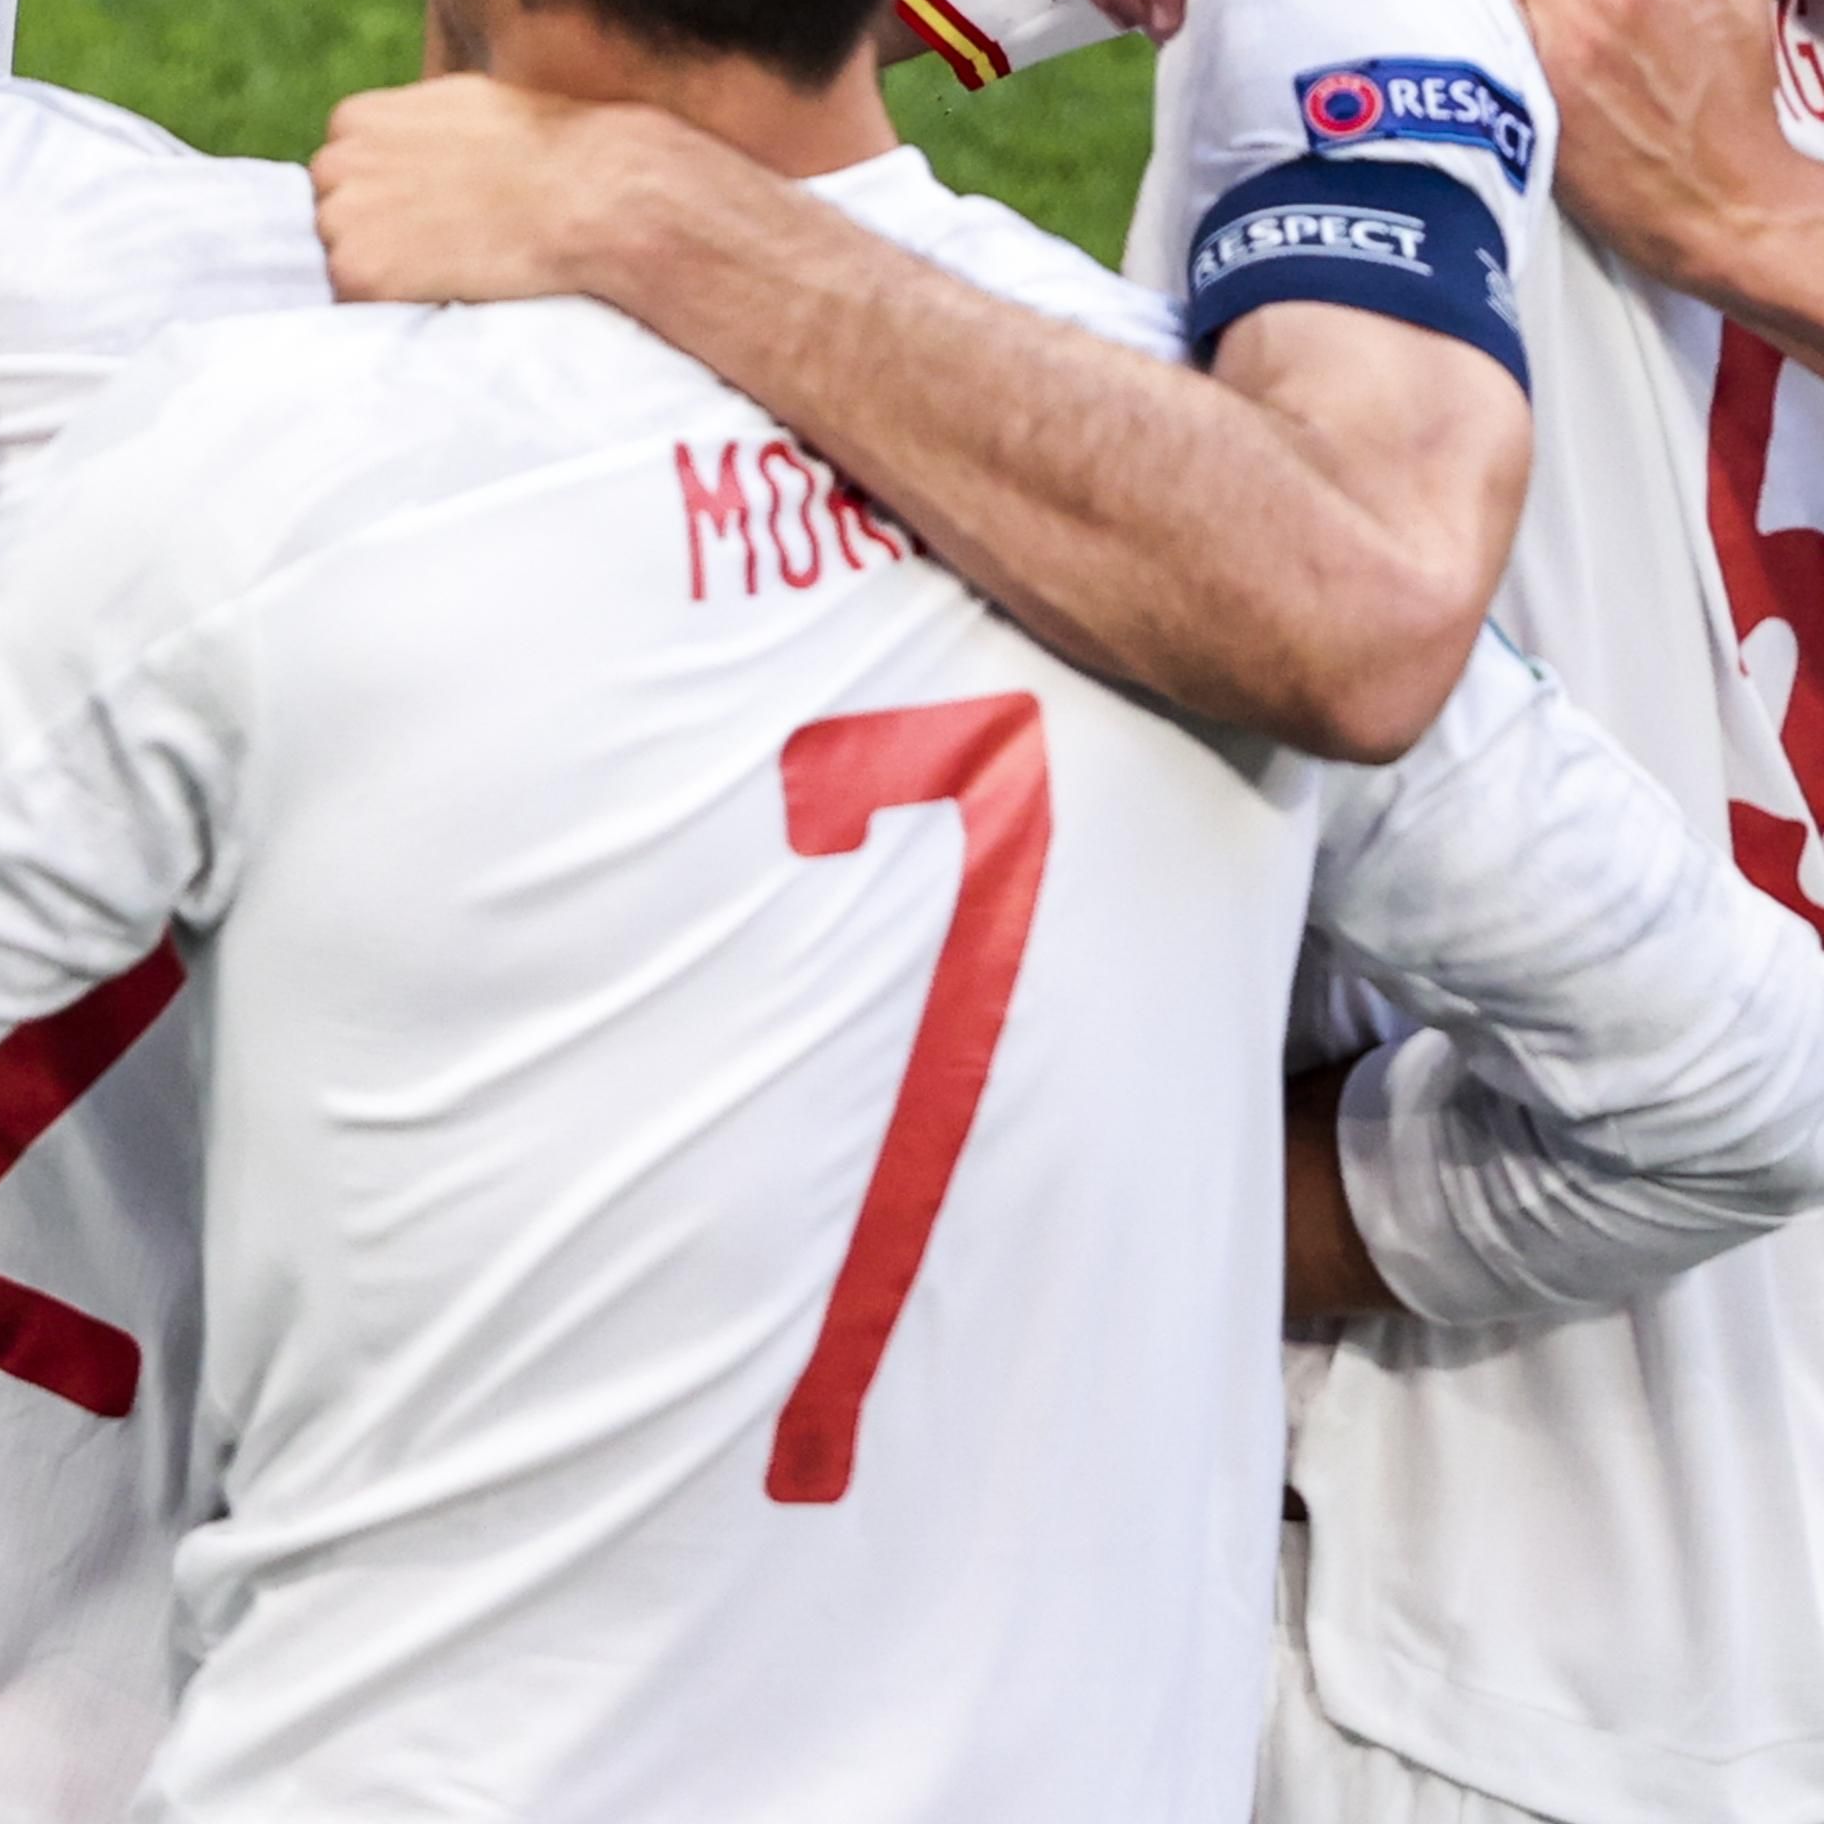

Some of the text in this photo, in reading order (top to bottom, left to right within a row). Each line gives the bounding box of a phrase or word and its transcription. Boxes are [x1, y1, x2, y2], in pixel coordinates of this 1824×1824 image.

[1388, 77, 1532, 166] RESPECT
[1194, 215, 1426, 288] RESPECT
[765, 690, 1054, 1504] 7
